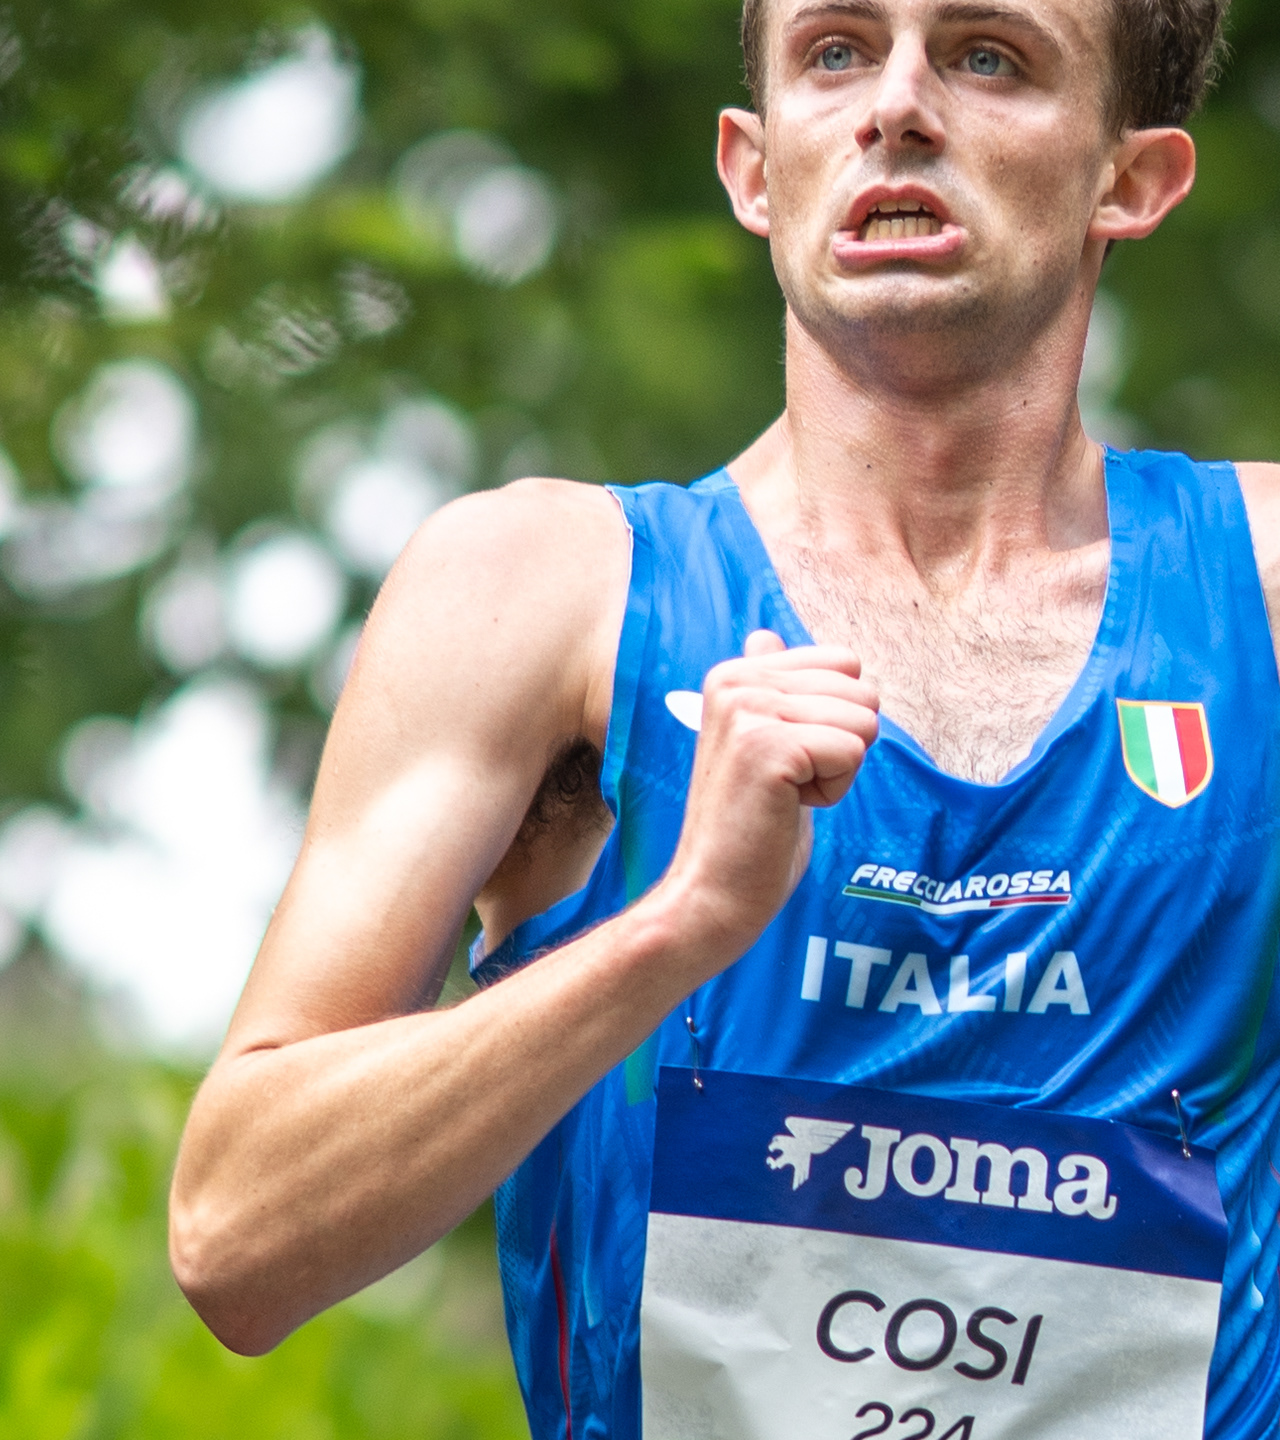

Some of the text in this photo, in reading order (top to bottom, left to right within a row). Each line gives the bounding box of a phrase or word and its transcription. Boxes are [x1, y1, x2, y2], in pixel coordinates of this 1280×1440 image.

[851, 863, 1071, 903] FRECCIAROSSA
[800, 935, 1091, 1016] ITALIA
[843, 1124, 1118, 1221] Joma
[815, 1289, 1045, 1386] COSI
